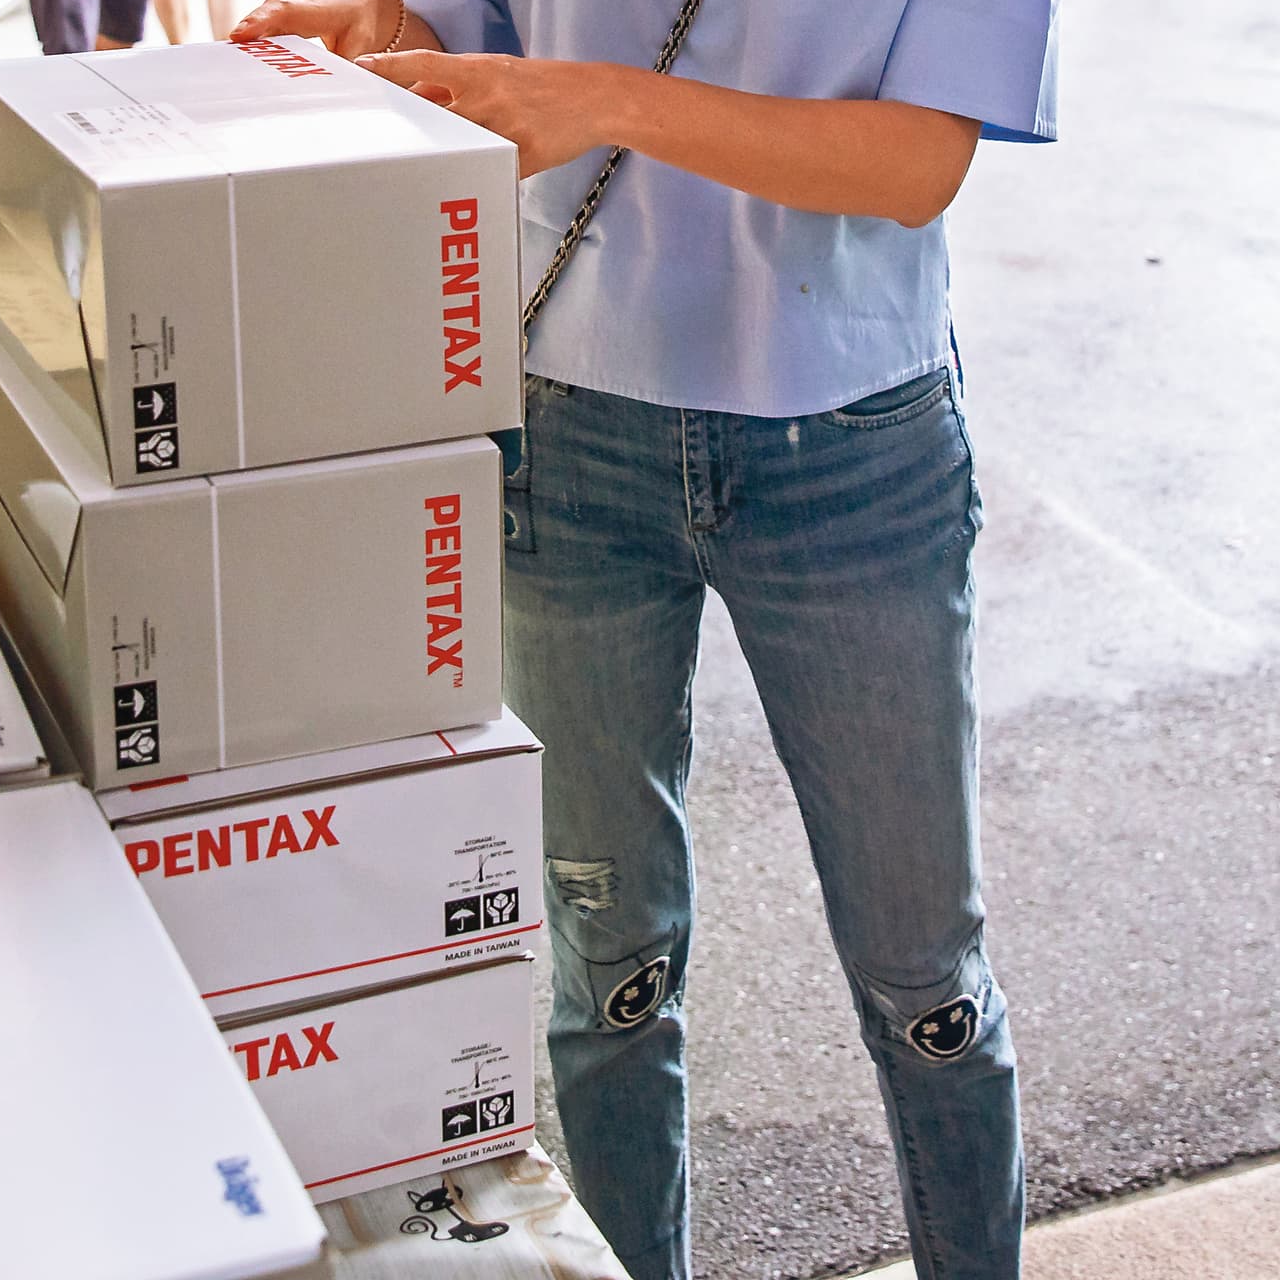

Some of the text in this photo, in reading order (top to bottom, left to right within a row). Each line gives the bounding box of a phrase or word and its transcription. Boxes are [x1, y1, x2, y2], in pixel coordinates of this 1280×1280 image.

[440, 198, 482, 394] PENTAX
[424, 494, 464, 676] PENTAX
[124, 805, 340, 878] PENTAX
[445, 939, 520, 961] MADE IN TAIWAN
[229, 1021, 340, 1081] TAX
[442, 1153, 468, 1165] MADE
[482, 1140, 516, 1154] TAIWAN
